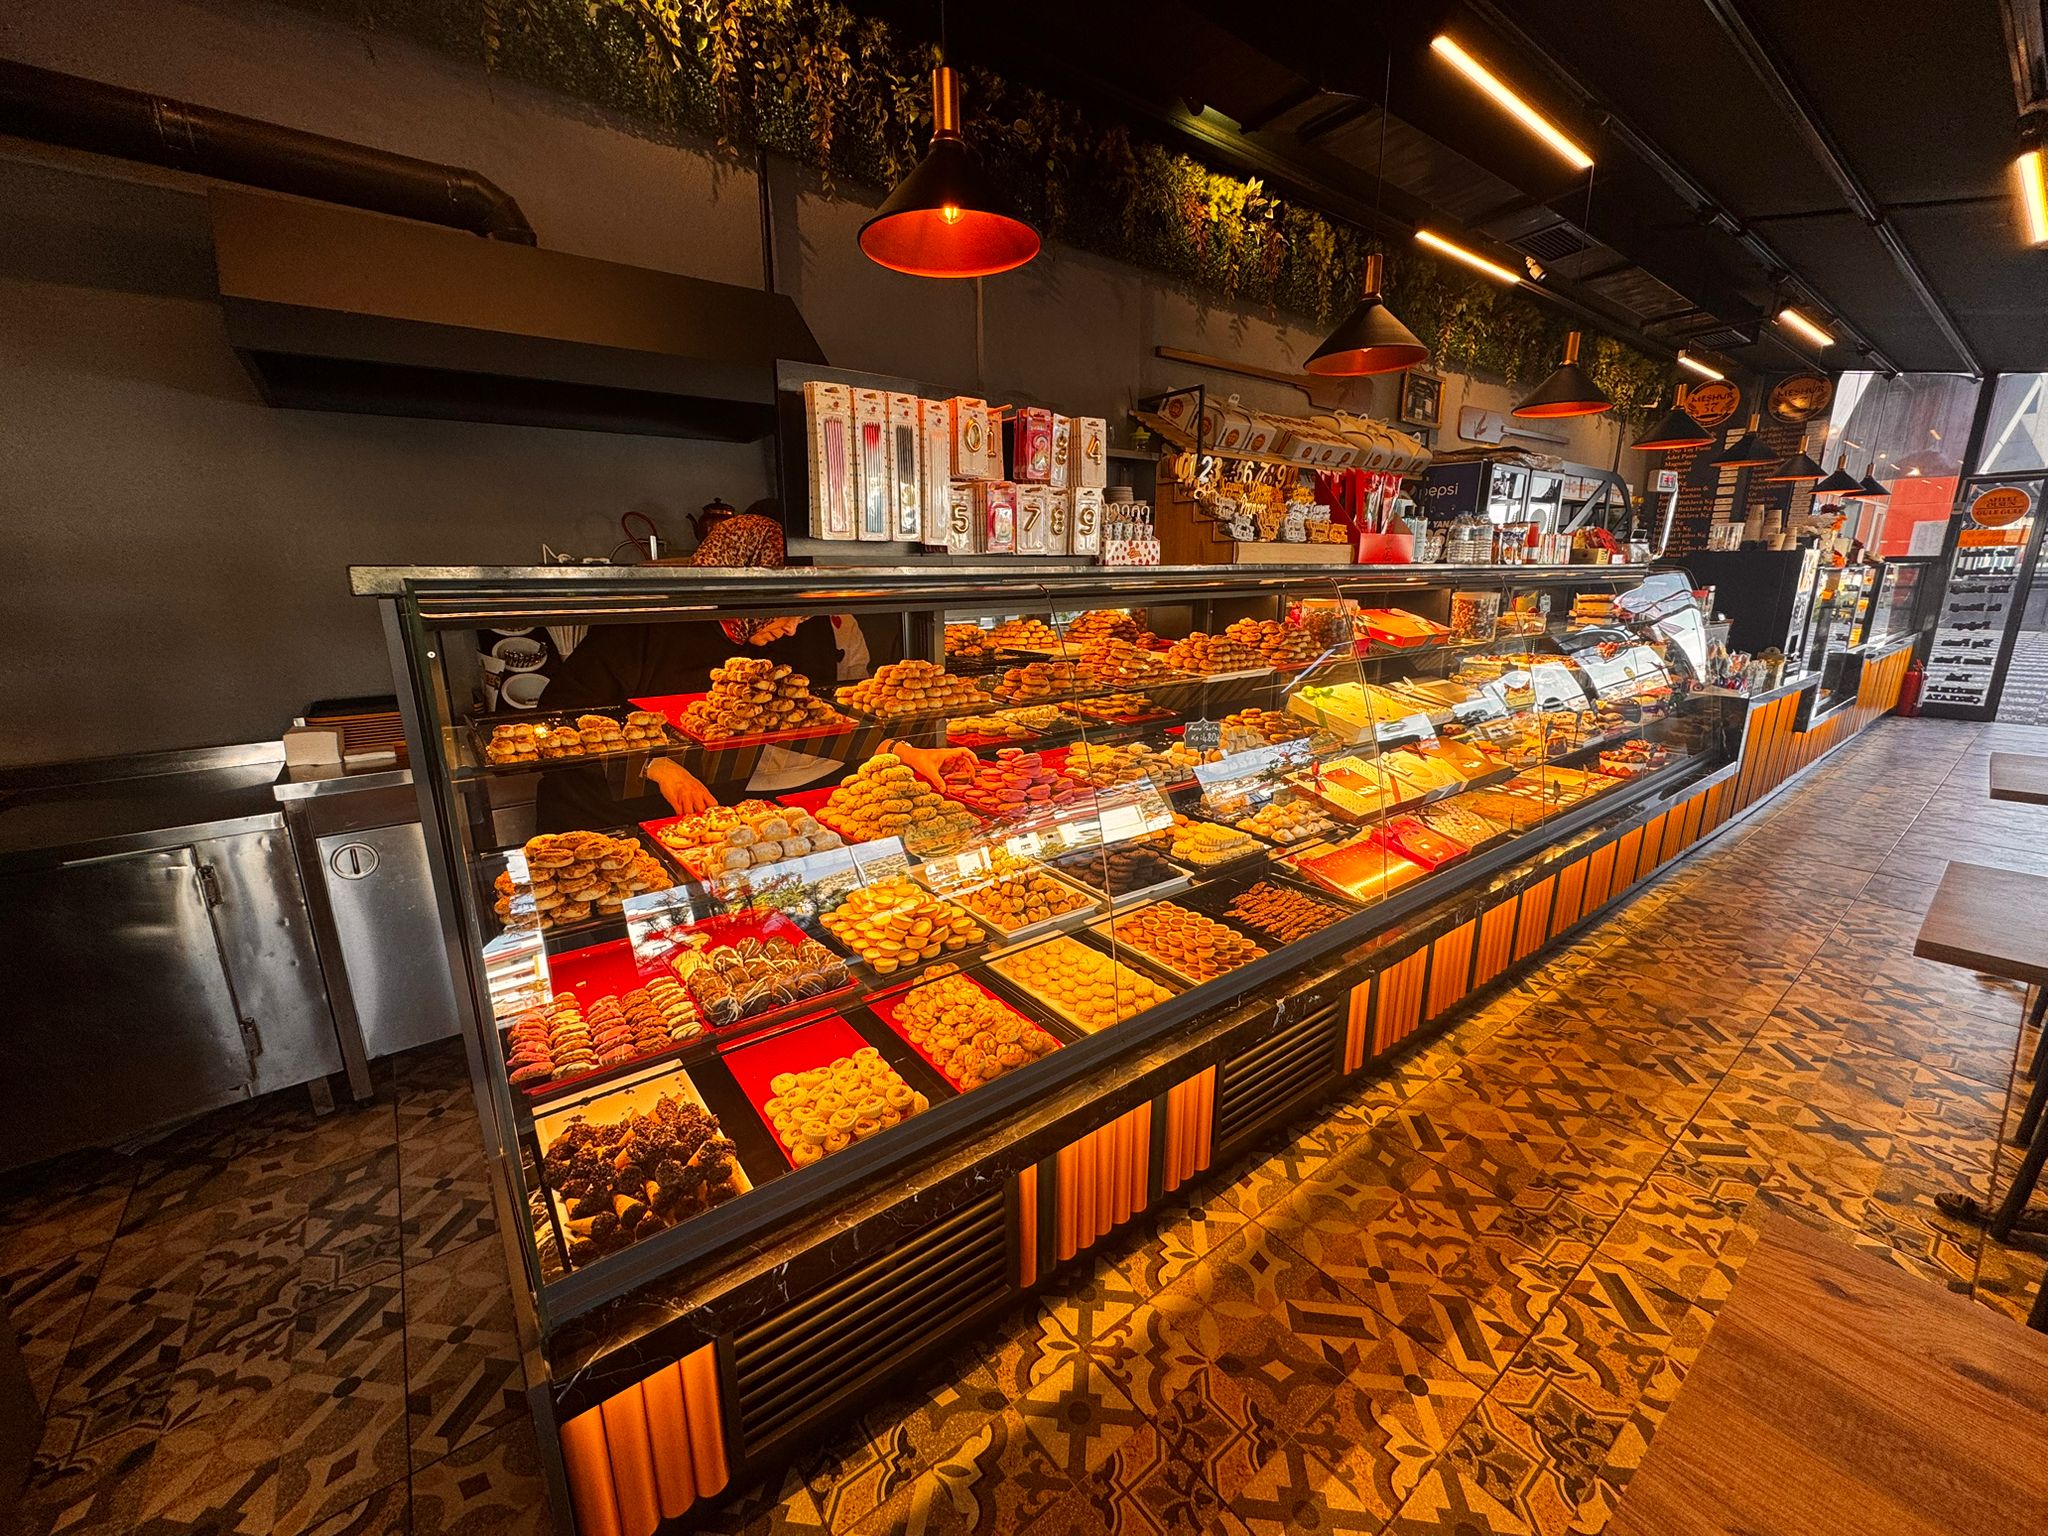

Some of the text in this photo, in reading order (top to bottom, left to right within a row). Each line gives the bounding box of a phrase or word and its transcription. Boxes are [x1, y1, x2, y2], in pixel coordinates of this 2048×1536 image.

[1087, 434, 1102, 465] 4
[952, 504, 970, 535] 5
[1023, 504, 1041, 532] 7
[1079, 507, 1097, 535] 9
